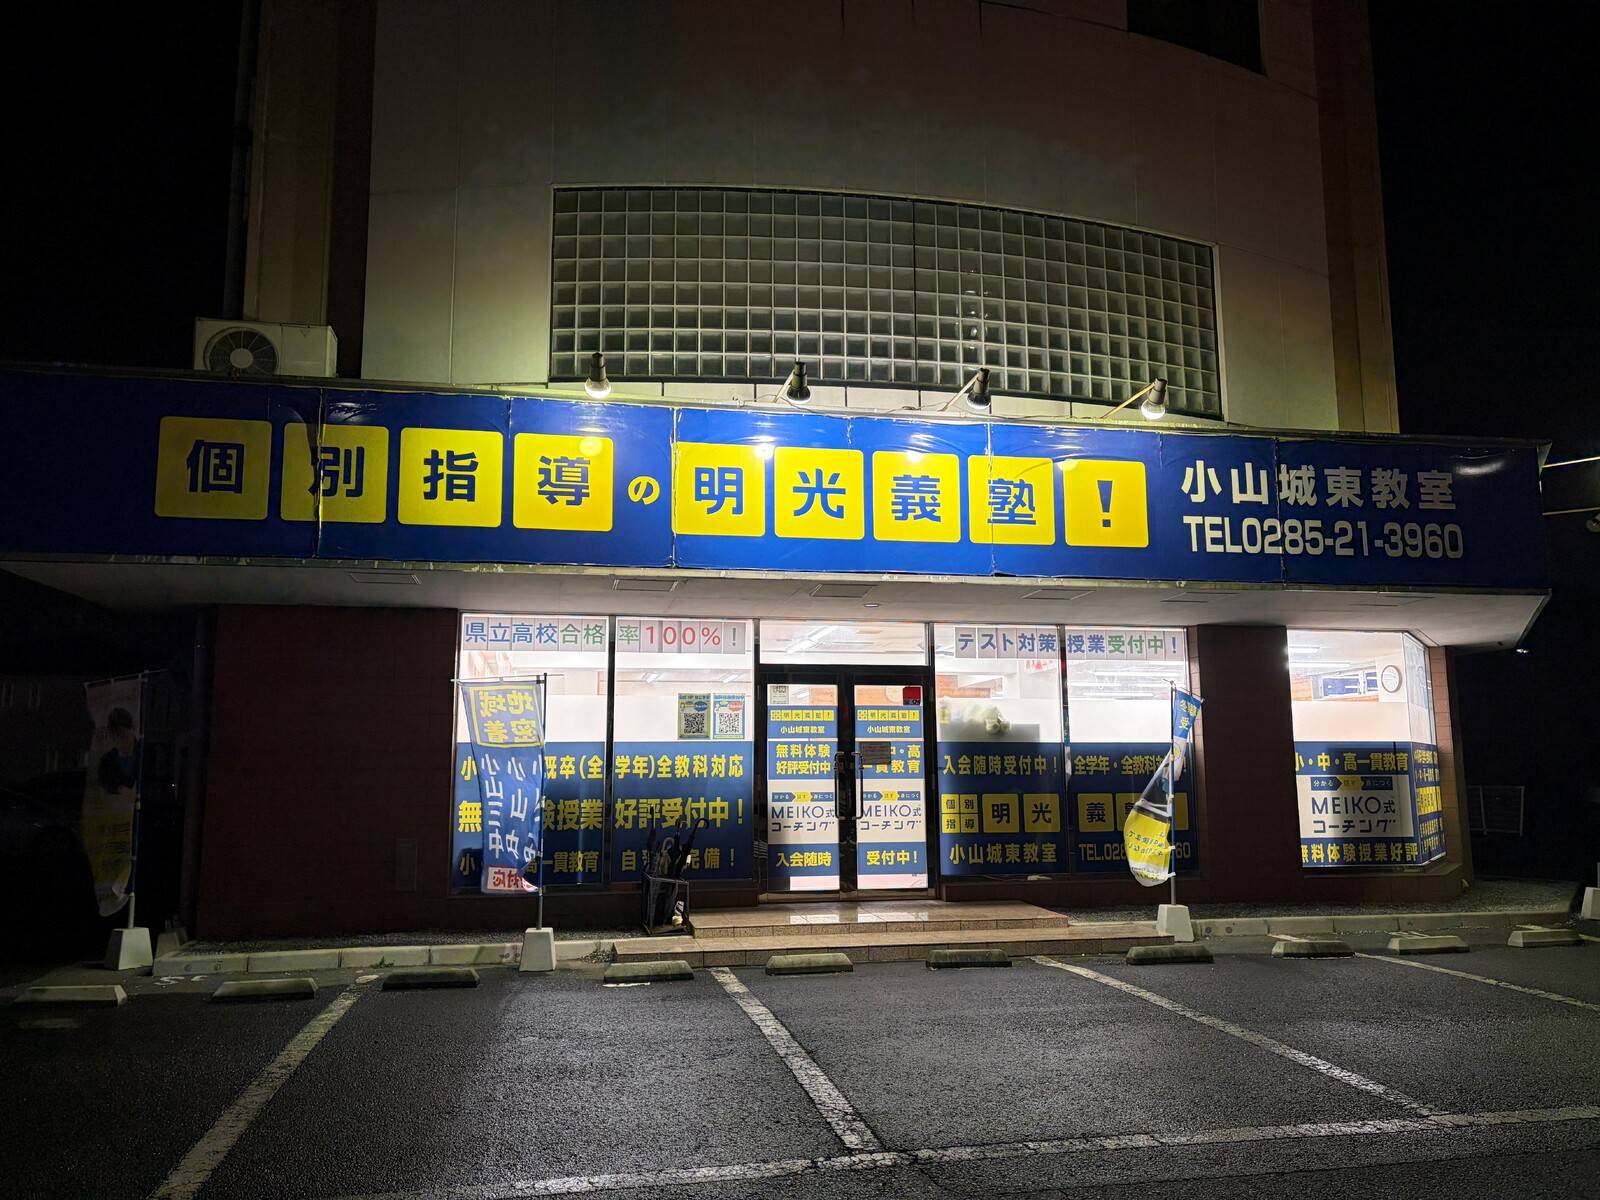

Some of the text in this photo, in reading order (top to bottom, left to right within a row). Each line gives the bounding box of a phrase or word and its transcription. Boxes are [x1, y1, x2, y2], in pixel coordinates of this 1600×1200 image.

[186, 439, 1112, 528] 個別指導の明光義塾!
[1181, 460, 1456, 509] 小山城東教室
[1183, 516, 1463, 559] TEL0285-21-3960
[465, 621, 738, 648] 県立高校合格率100%!
[957, 632, 1177, 655] テスト対策授業受付中!
[775, 743, 831, 759] 無料体験
[775, 760, 831, 775] 好評受付中
[943, 754, 1057, 775] 入会随時受付中!
[771, 806, 835, 819] MEIKO式
[1312, 796, 1396, 814] MEIKO式
[771, 820, 835, 831] コーチング
[860, 820, 922, 831] コーチング
[1313, 819, 1396, 834] コーチング
[775, 852, 832, 867] 入会随時
[866, 850, 919, 865] 受付中!
[949, 842, 1057, 865] 小山城東教室
